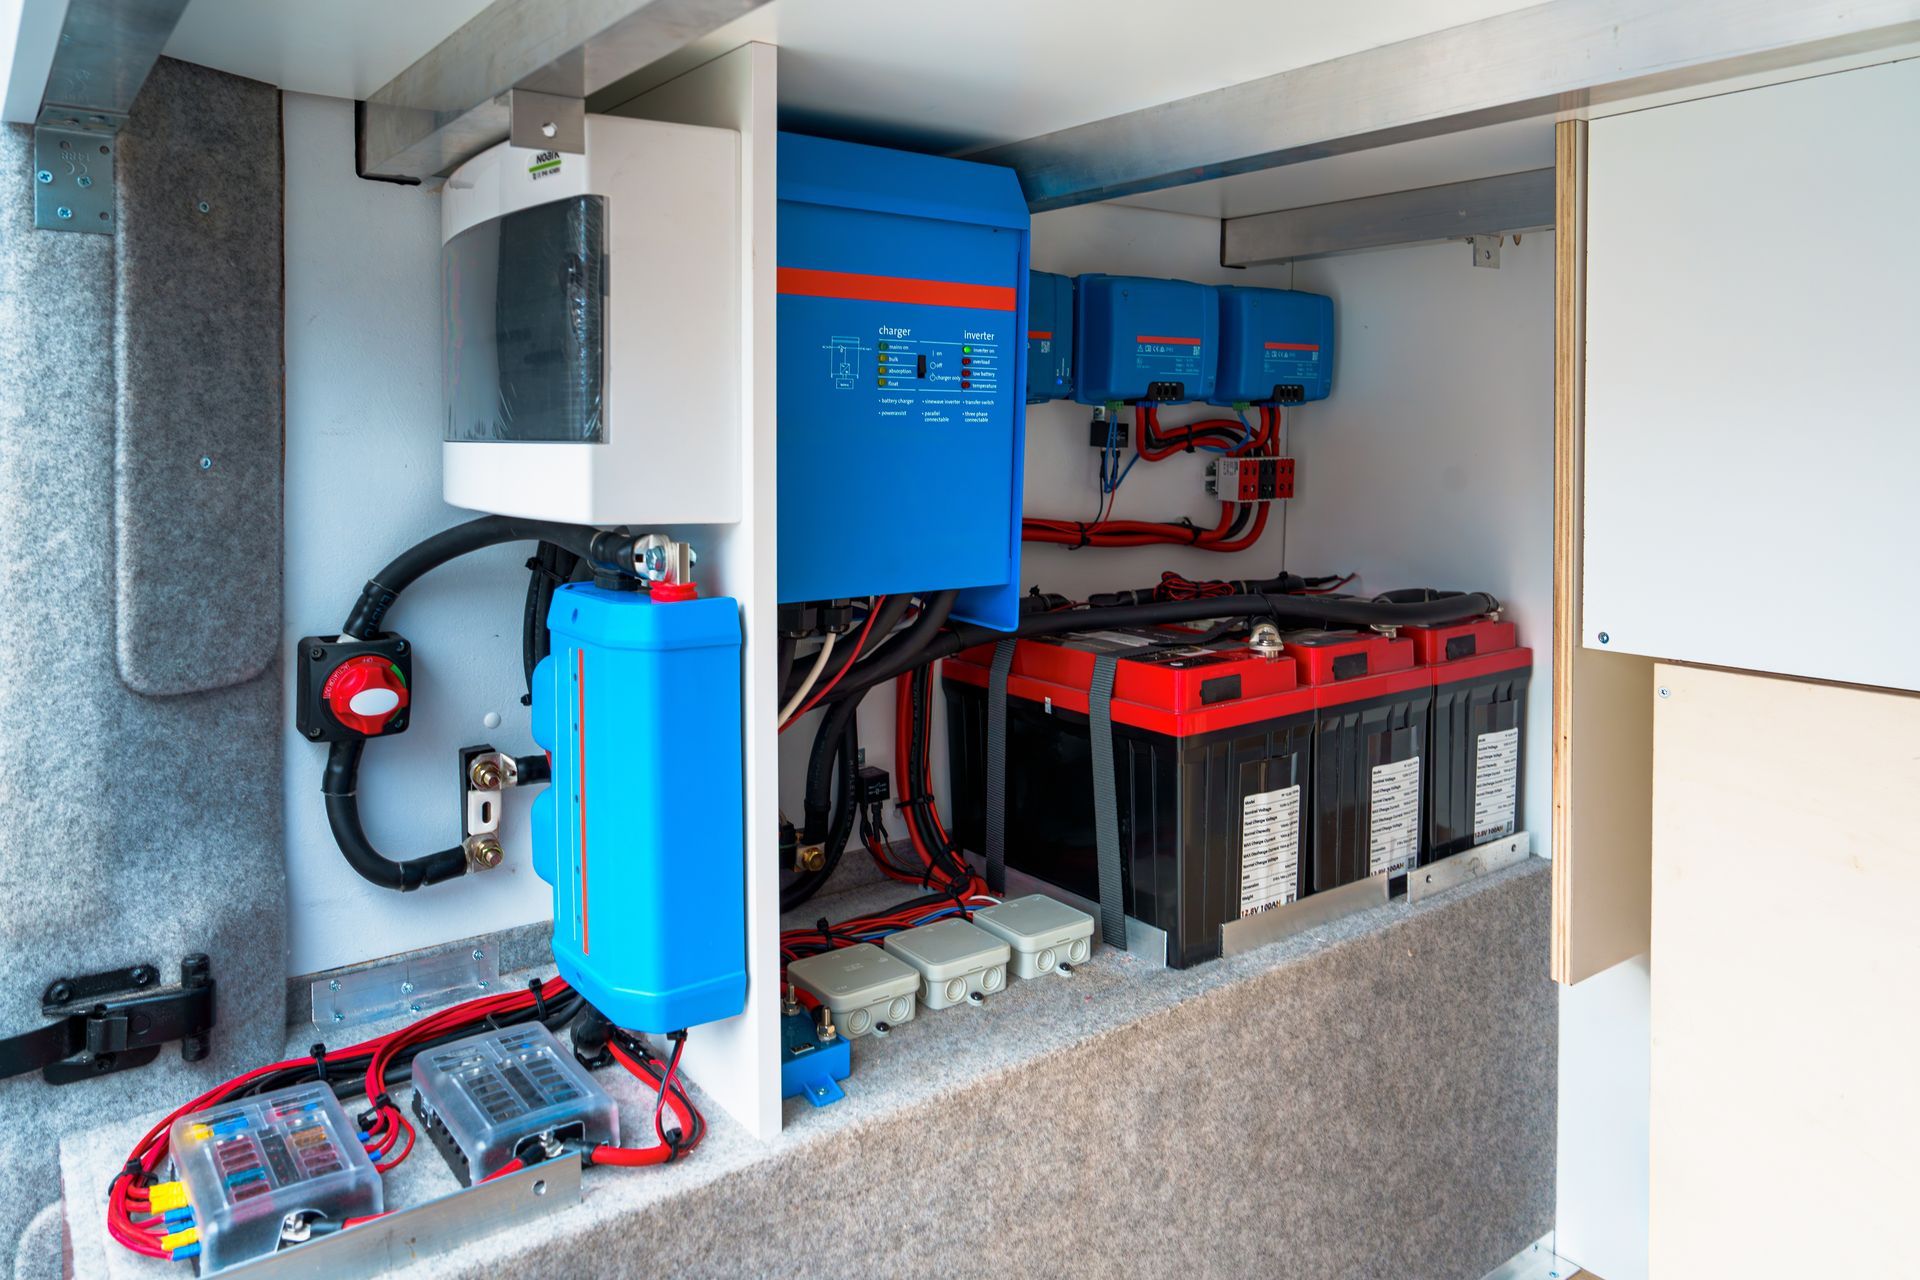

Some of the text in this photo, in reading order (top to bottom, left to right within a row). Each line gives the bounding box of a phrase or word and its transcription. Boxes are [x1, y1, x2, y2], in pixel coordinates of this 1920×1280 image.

[878, 325, 911, 339] charger
[964, 330, 995, 341] inverter
[1241, 899, 1281, 917] 12.8V 100AH
